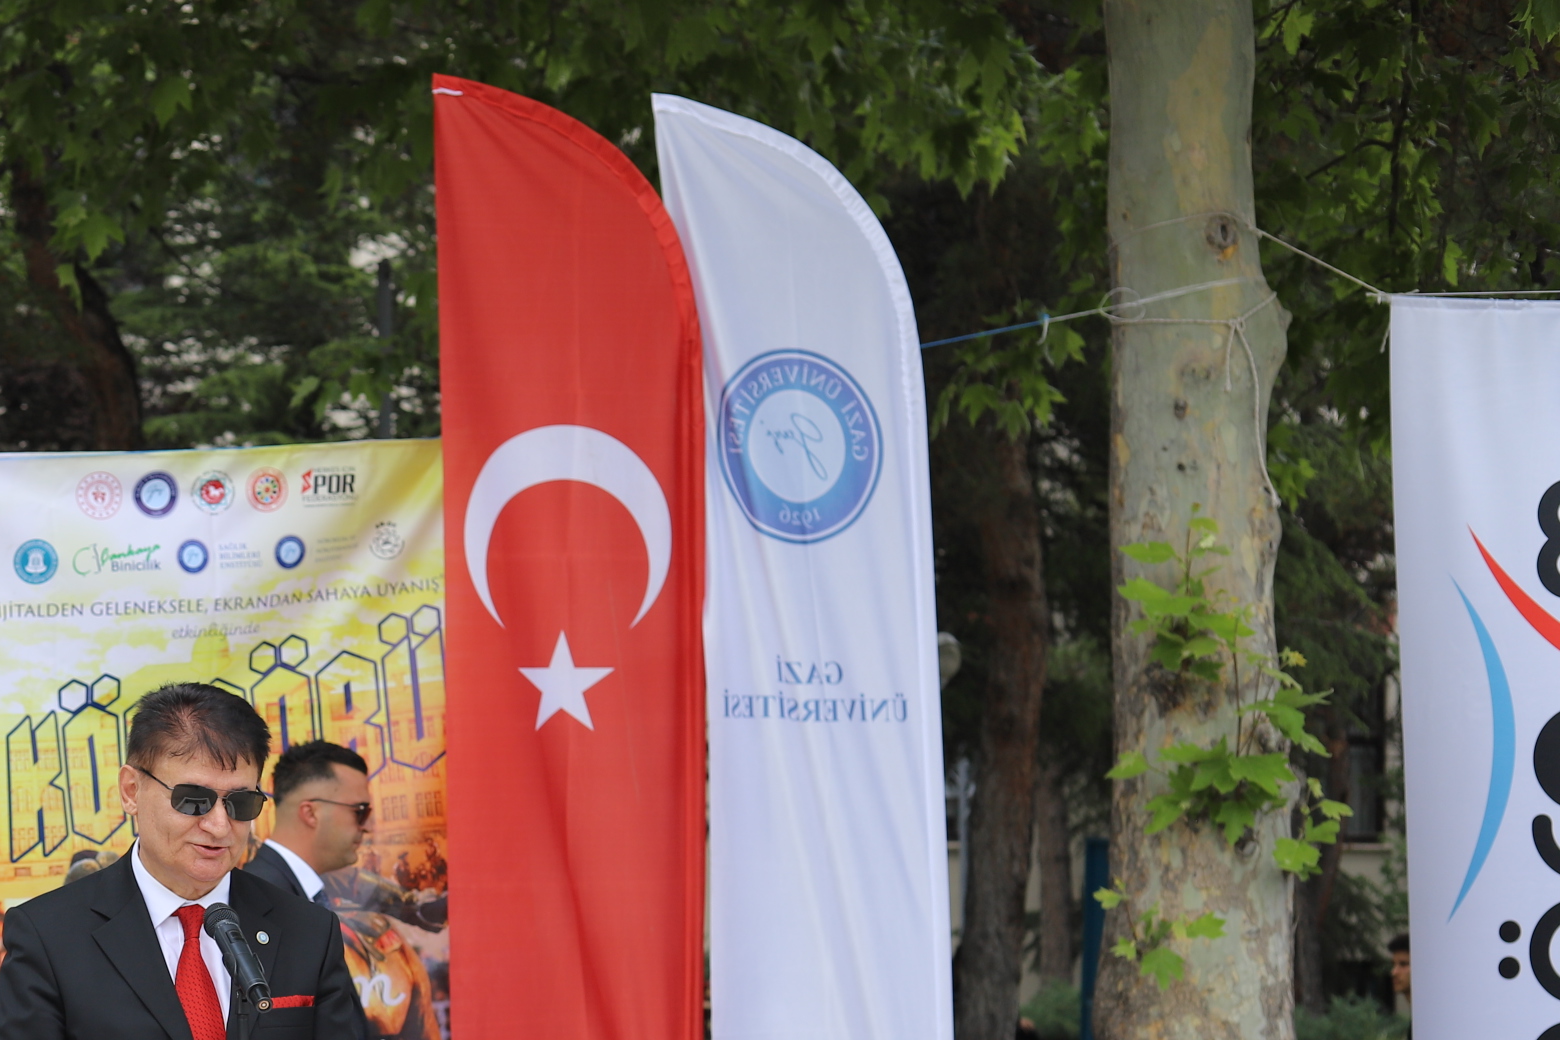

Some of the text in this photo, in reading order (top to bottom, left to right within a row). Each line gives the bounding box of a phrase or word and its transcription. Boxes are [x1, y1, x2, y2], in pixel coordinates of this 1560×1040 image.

[301, 467, 356, 495] SPOR
[110, 559, 162, 573] Binicilik
[90, 597, 208, 618] GELENEKSELE,
[214, 591, 303, 612] EKRANDAN
[307, 583, 373, 603] SAHAYA
